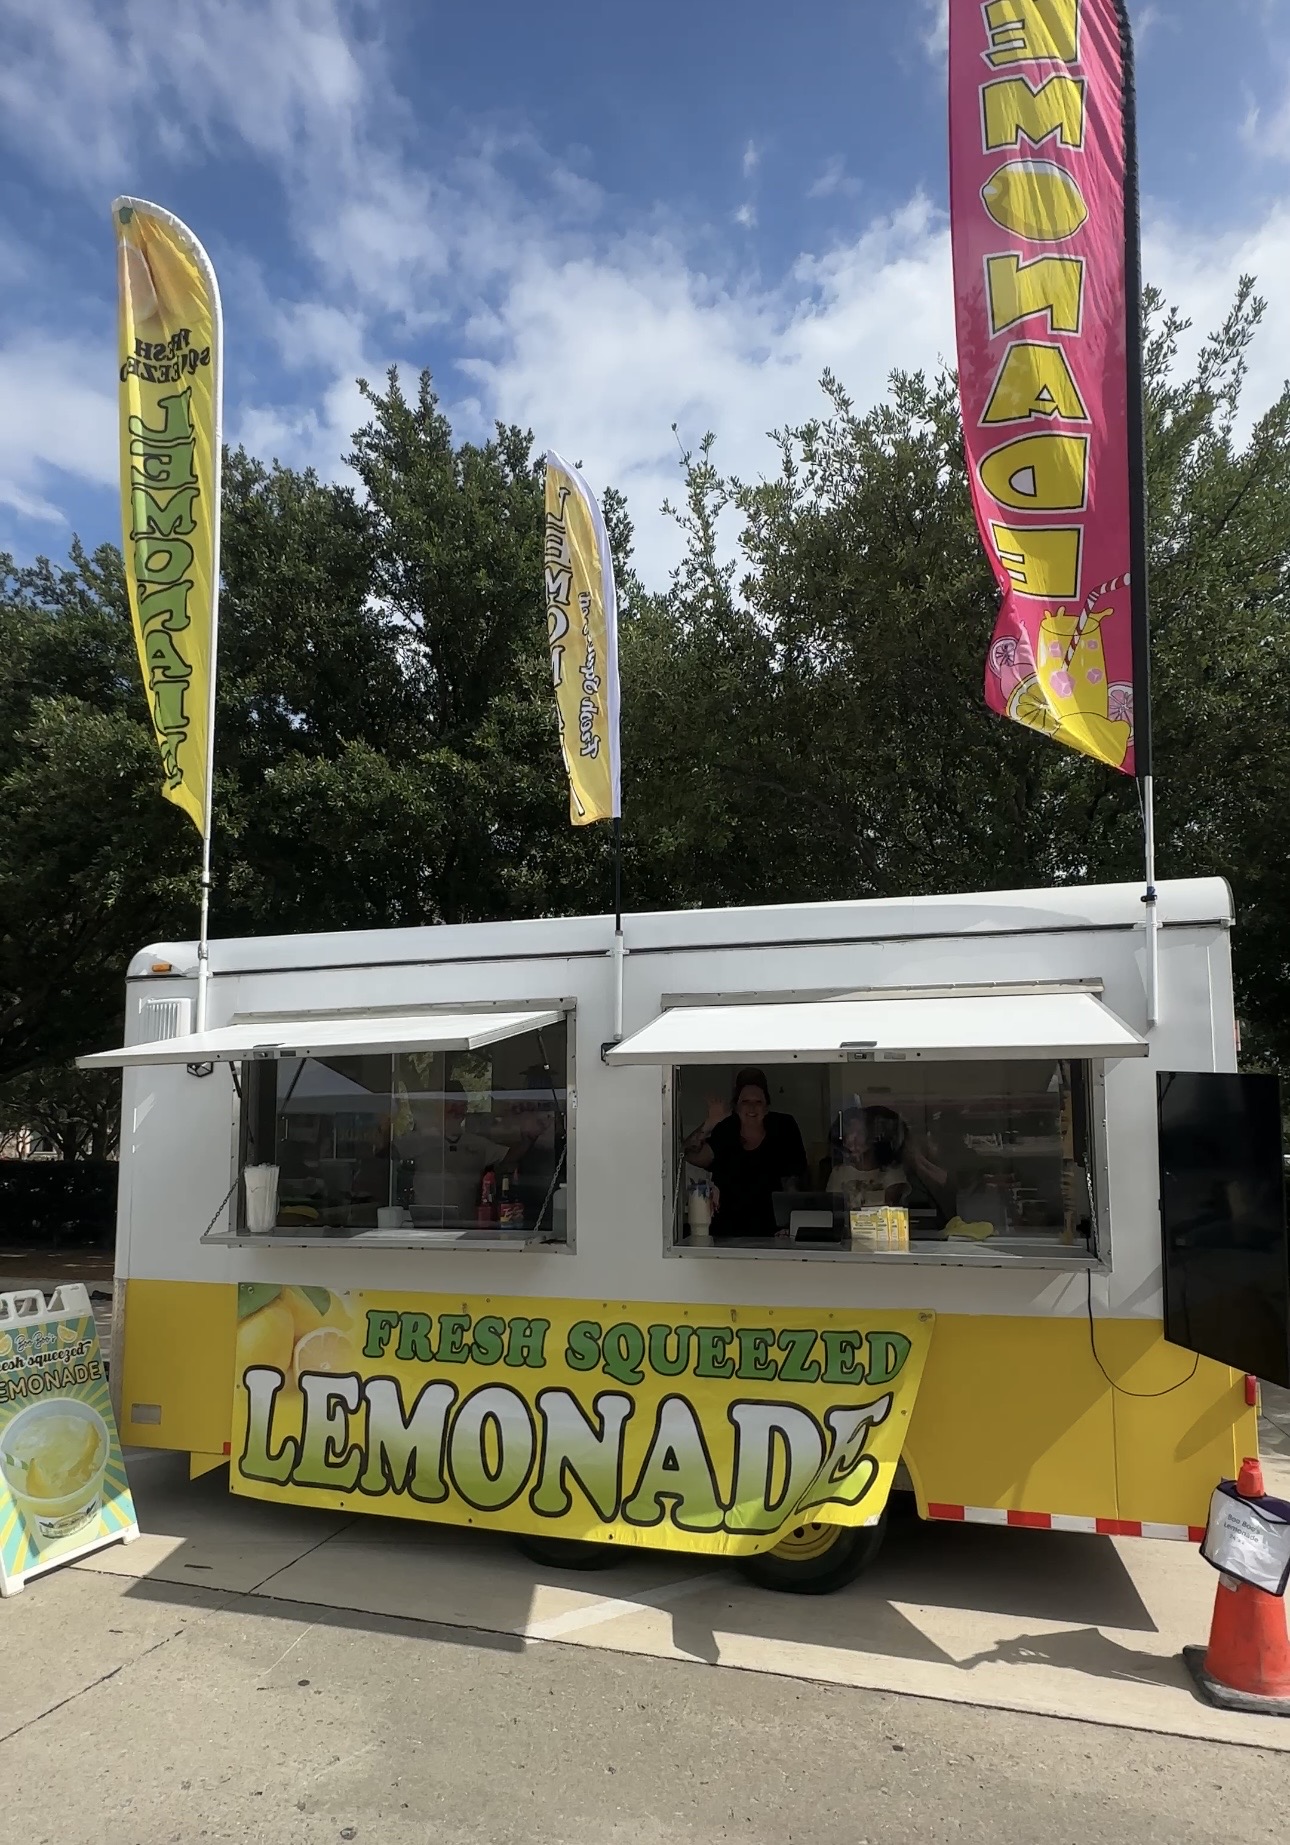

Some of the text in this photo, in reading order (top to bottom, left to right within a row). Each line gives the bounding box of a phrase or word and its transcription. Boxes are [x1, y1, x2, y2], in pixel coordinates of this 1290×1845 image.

[27, 1340, 92, 1367] squeezed
[364, 1309, 912, 1384] FRESH SQUEEZED
[238, 1365, 894, 1534] LEMONADE
